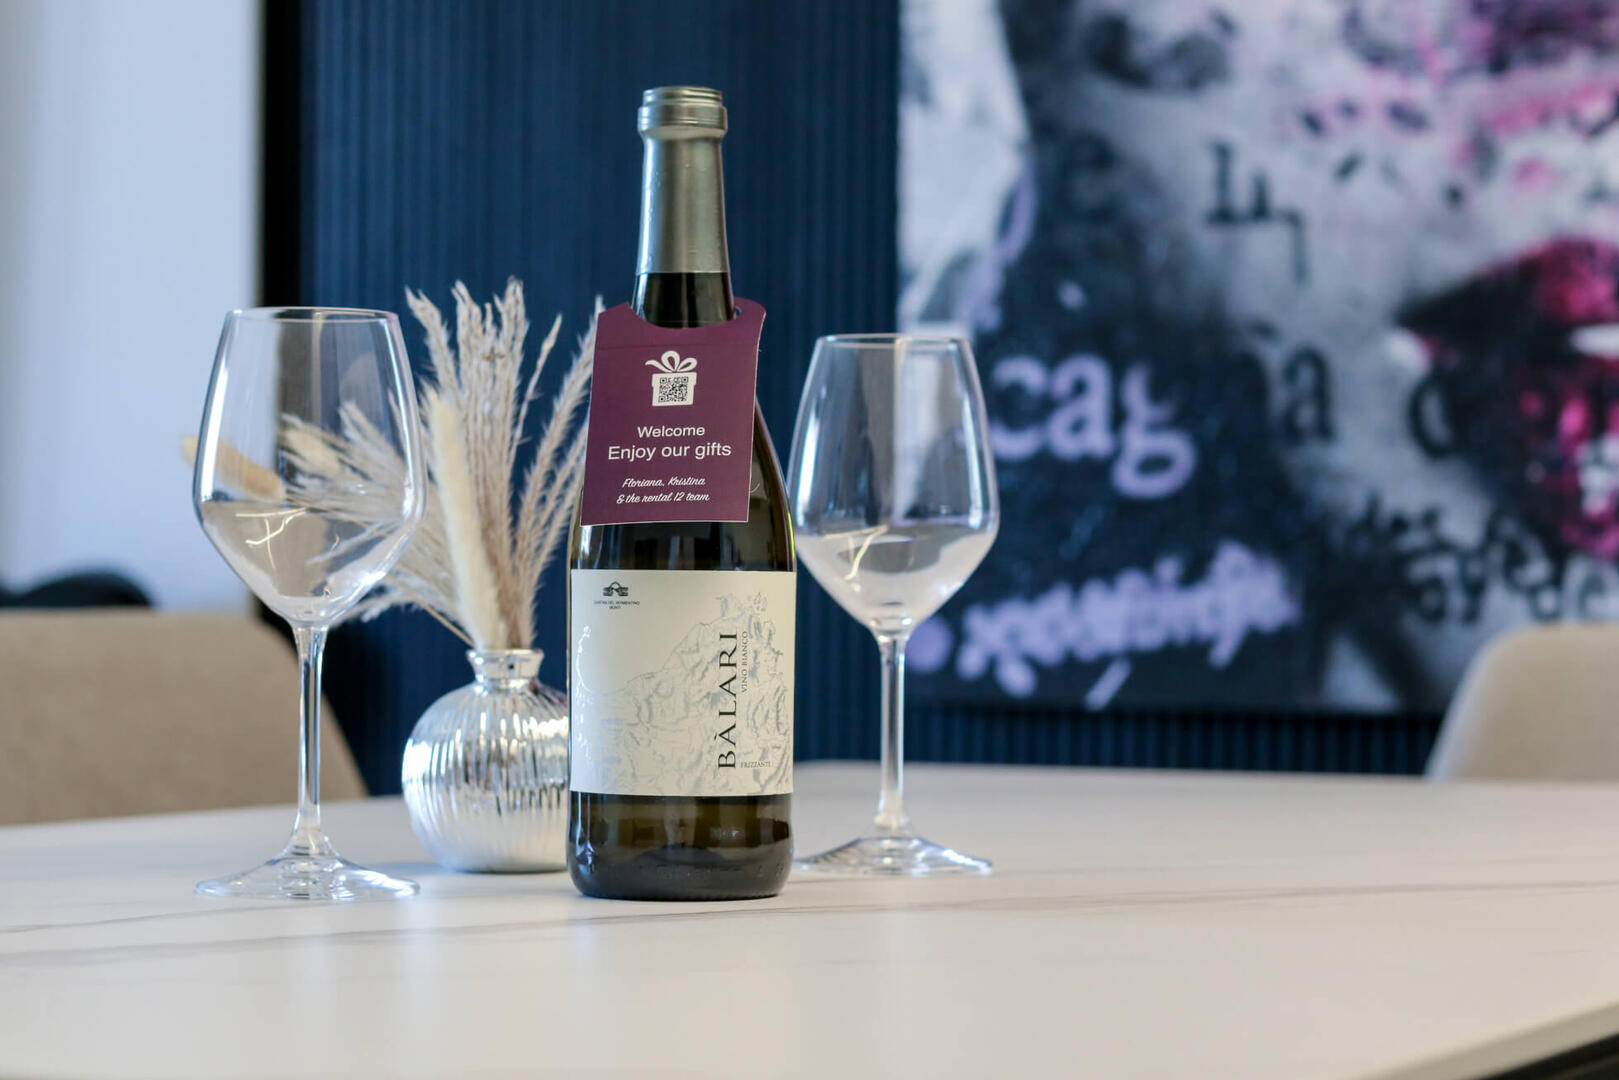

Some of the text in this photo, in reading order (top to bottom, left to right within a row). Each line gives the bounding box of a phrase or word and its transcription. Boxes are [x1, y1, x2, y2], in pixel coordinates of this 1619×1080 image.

[637, 425, 705, 438] Welcome
[608, 442, 732, 462] Enjoy our gifts
[667, 477, 706, 487] Kristina
[641, 491, 672, 503] rental
[673, 491, 684, 502] 12
[685, 491, 711, 502] team
[741, 631, 749, 693] VINO BIANCO
[714, 632, 738, 768] BÀLARI
